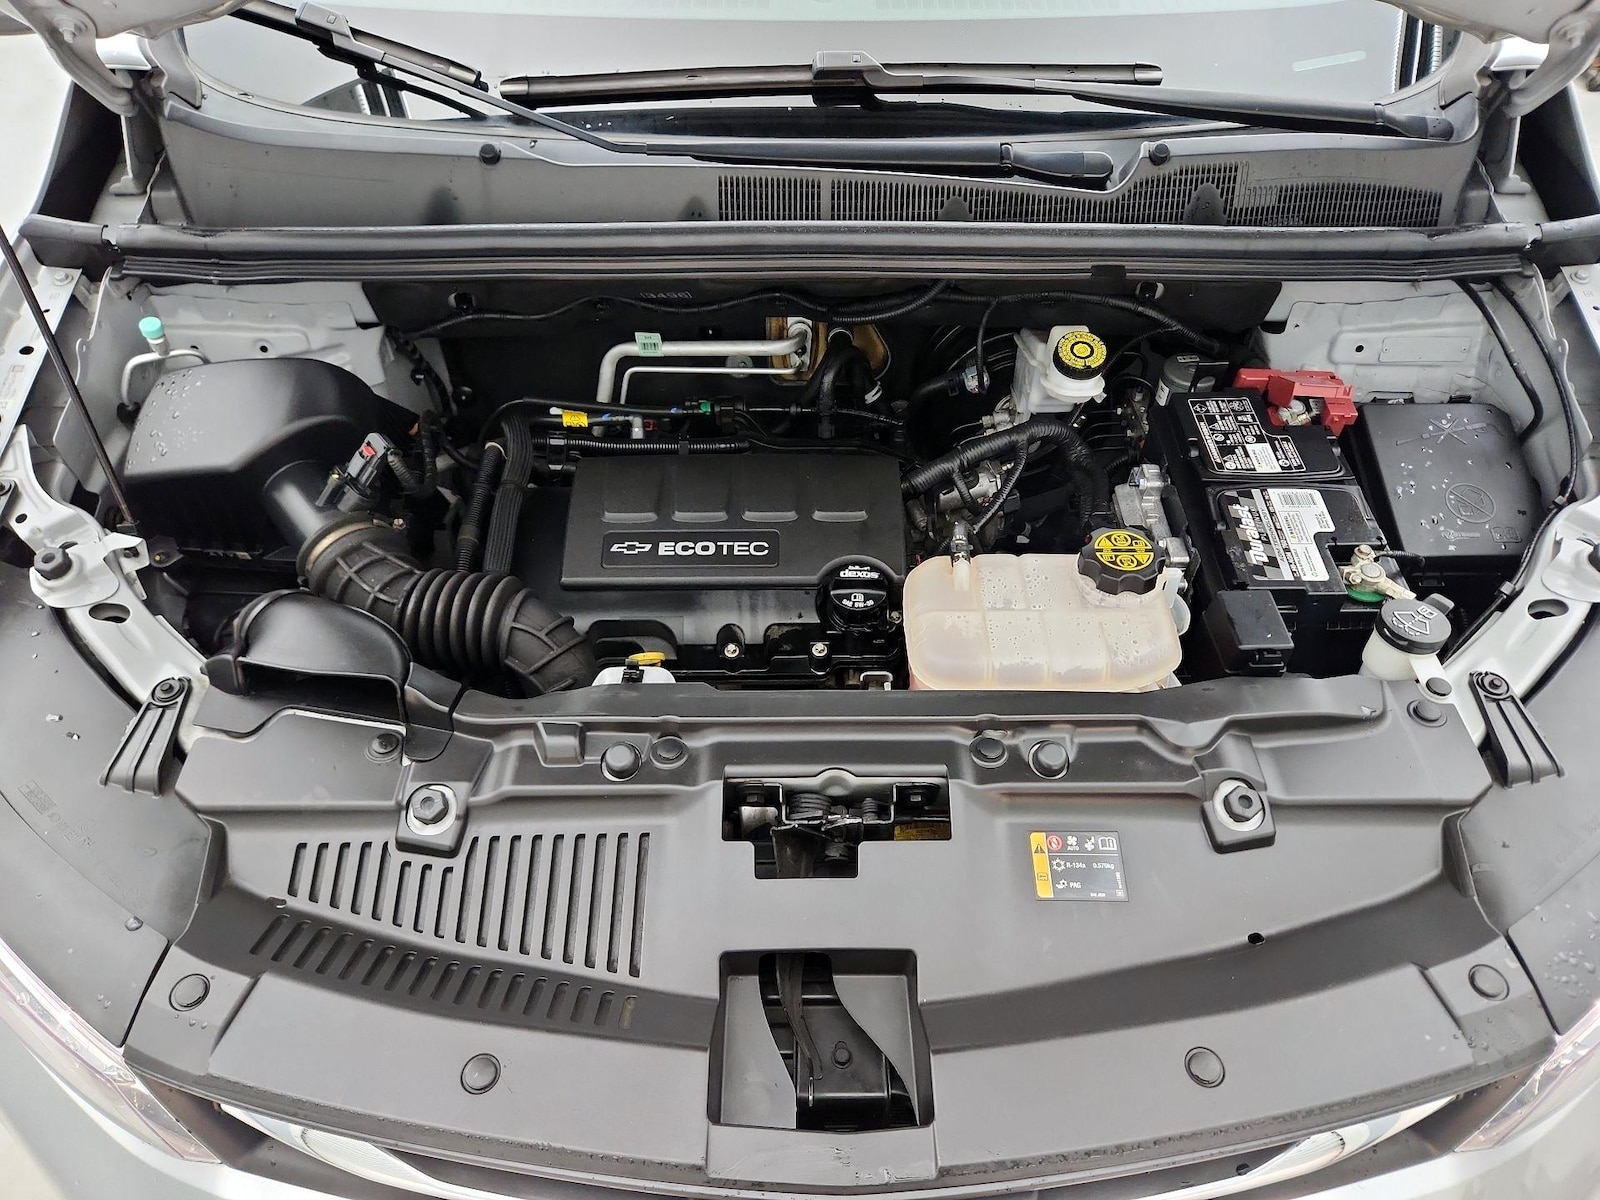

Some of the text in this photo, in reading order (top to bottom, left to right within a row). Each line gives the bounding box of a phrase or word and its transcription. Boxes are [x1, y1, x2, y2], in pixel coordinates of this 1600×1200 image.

[1233, 504, 1269, 564] Duralast
[658, 541, 769, 556] ECOTEC
[840, 569, 880, 579] dexos
